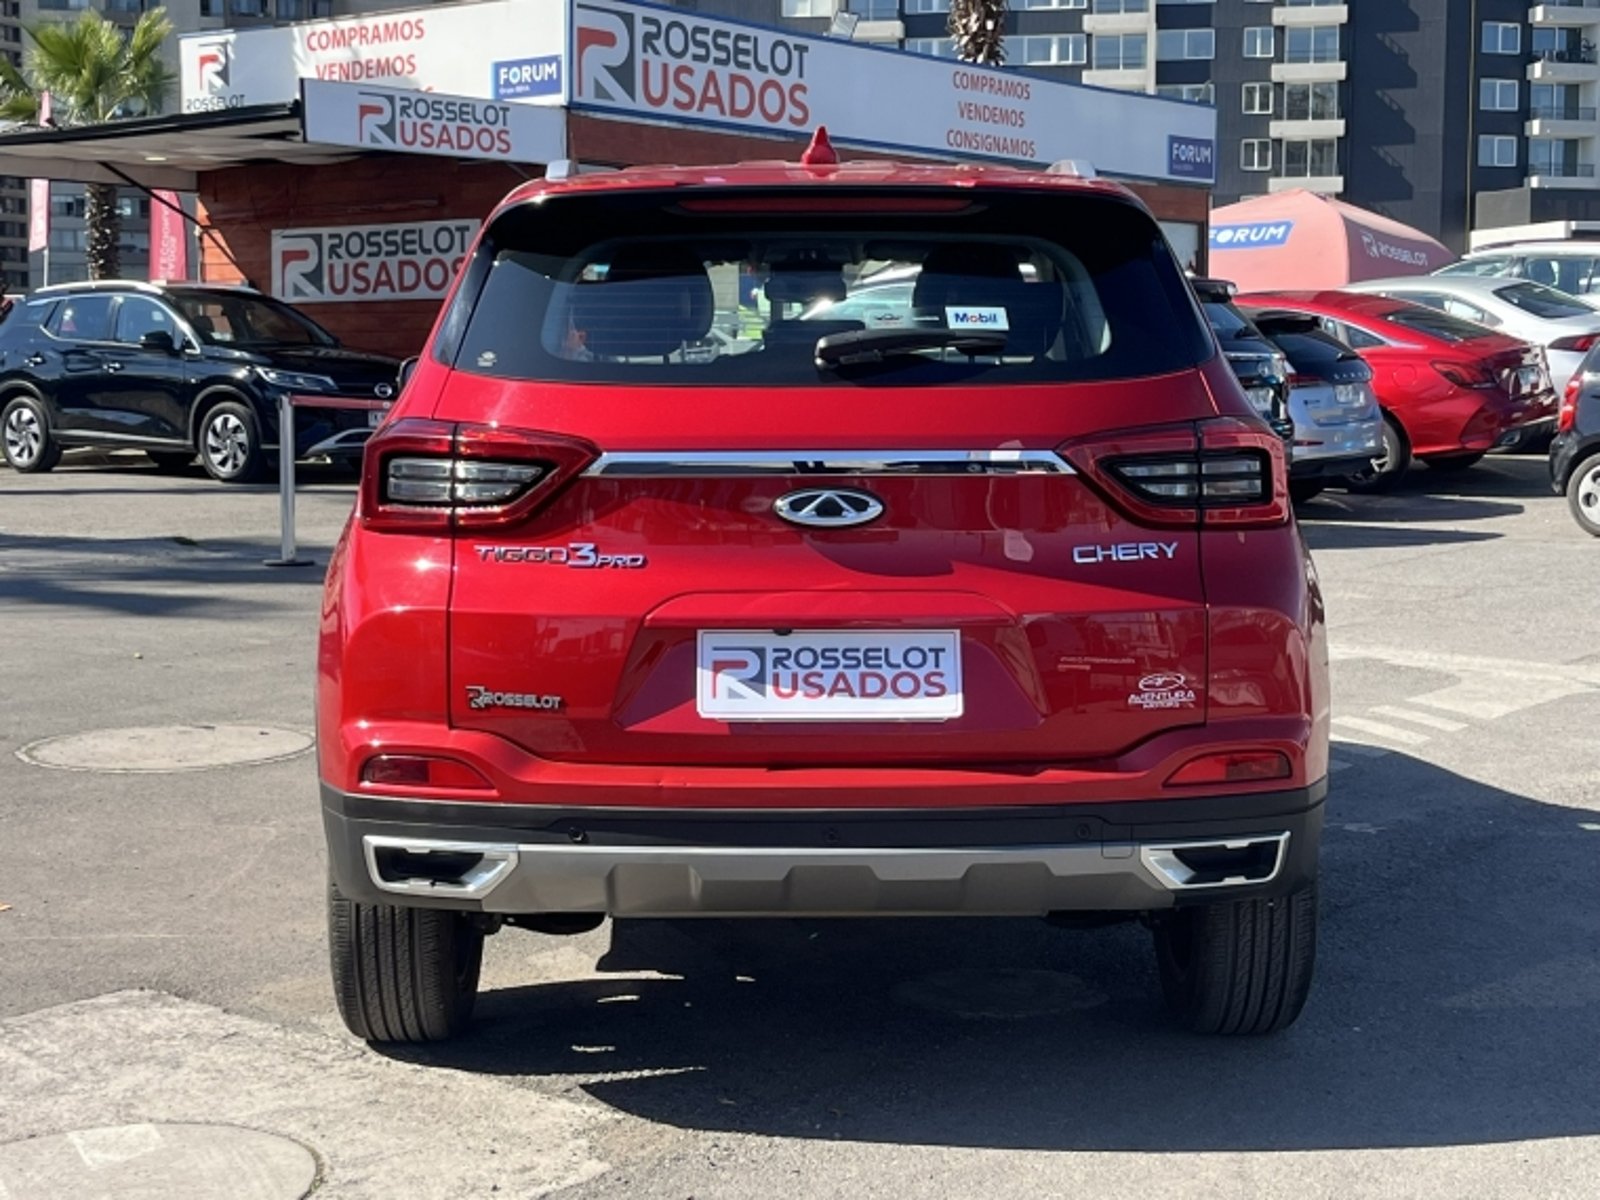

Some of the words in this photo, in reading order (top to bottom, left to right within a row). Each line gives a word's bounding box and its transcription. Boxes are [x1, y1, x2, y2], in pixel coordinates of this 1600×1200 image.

[306, 18, 425, 51] COMPRAMOS
[642, 16, 809, 79] ROSSELOT
[315, 54, 417, 81] VENDEMOS
[499, 61, 558, 86] FORUM
[642, 60, 810, 127] USADOS
[952, 70, 1031, 100] COMPRAMOS
[400, 97, 510, 127] ROSSELOT
[957, 101, 1025, 128] VENDEMOS
[400, 120, 512, 154] USADOS
[946, 129, 1036, 158] CONSIGNAMOS
[1172, 142, 1212, 164] FORUM
[327, 225, 470, 260] ROSSELOT
[1377, 242, 1429, 266] ROSSELOT
[955, 312, 998, 323] Mobil
[1073, 541, 1178, 564] CHERY
[772, 647, 946, 670] ROSSELOT
[772, 671, 948, 699] USADOS
[482, 692, 562, 709] ROSSELOT
